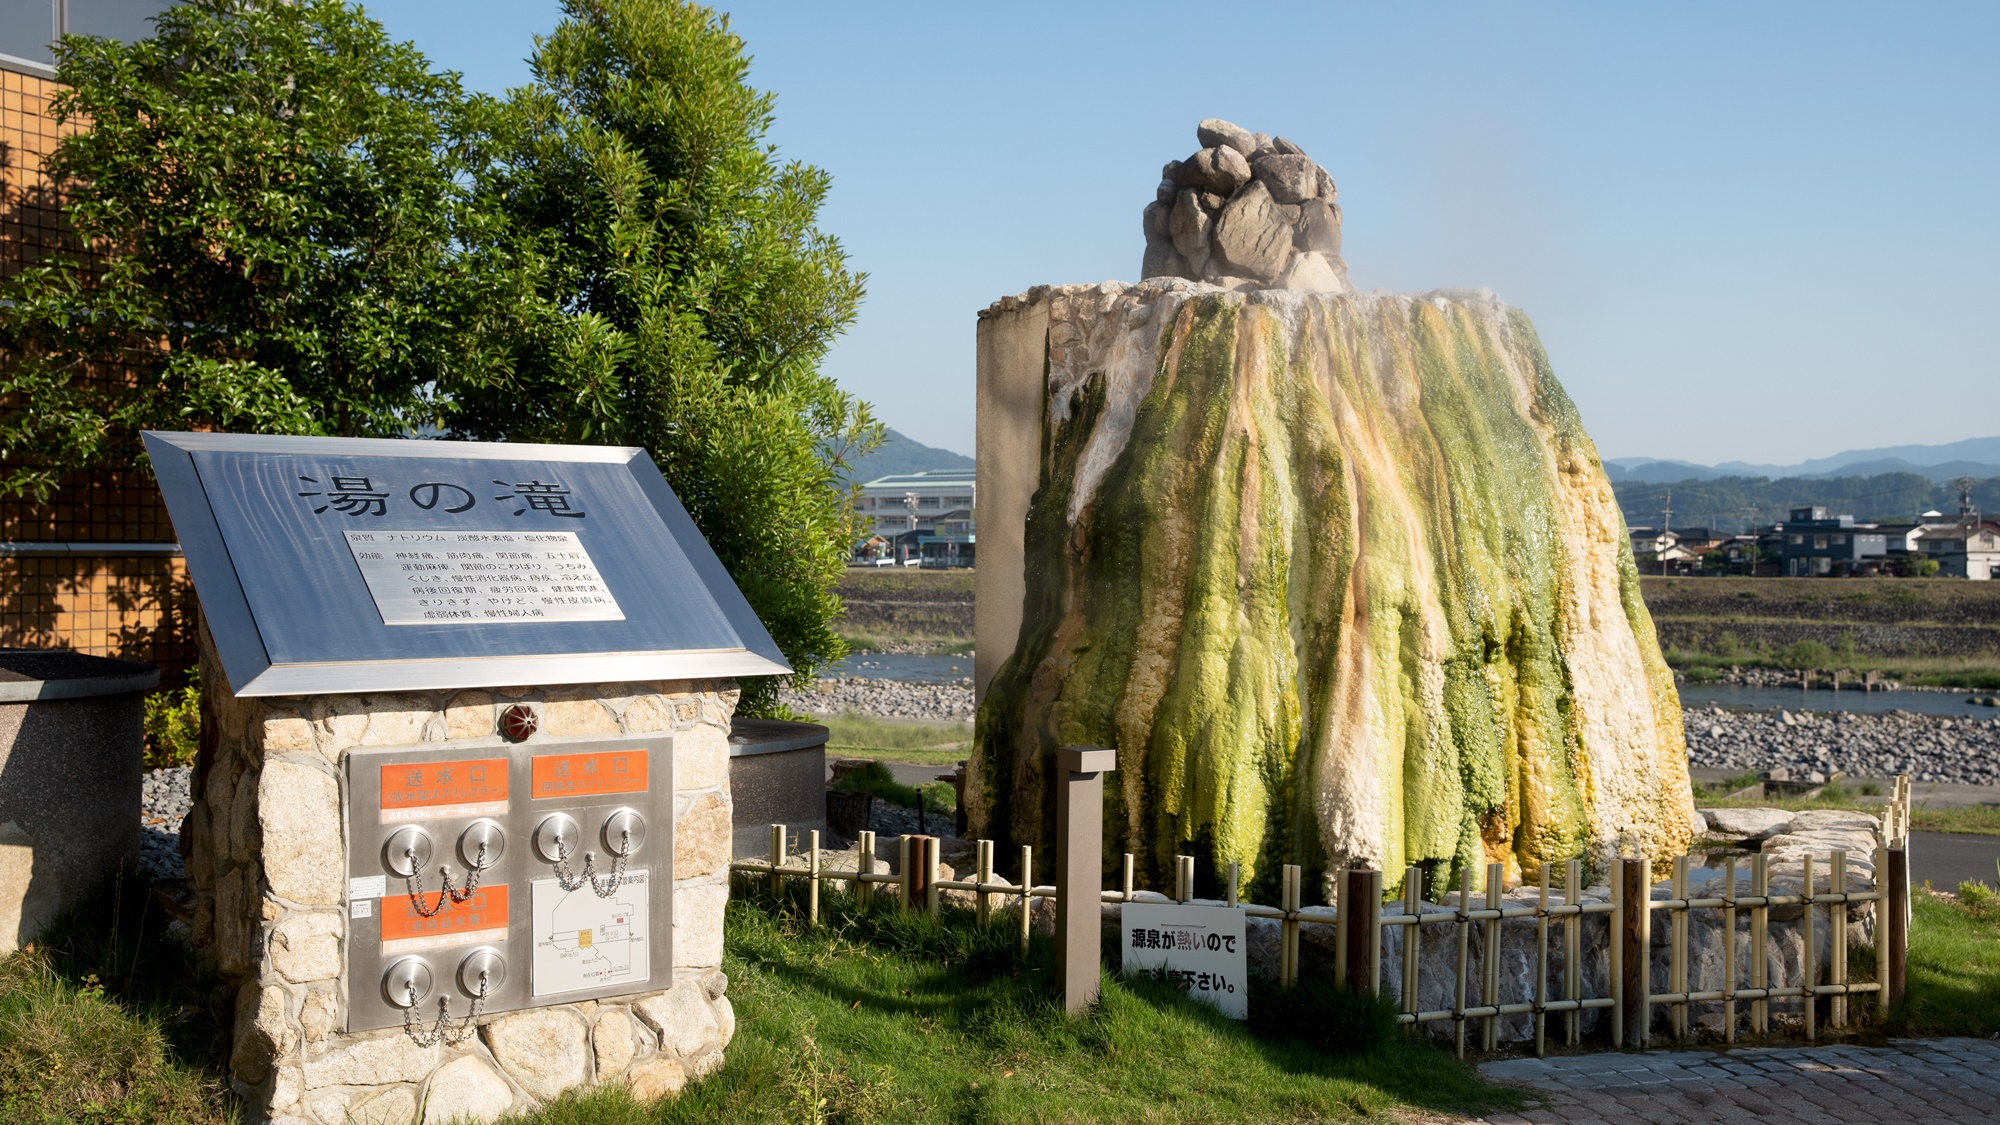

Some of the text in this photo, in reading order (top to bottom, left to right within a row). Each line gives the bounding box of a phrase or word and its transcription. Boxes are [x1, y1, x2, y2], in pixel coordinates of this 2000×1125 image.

[298, 475, 586, 519] 湯の滝
[350, 533, 375, 542] 泉質
[358, 552, 385, 560] 効能
[405, 766, 486, 787] 送水口
[553, 757, 628, 778] 送水口
[1131, 928, 1237, 954] 源泉が熱いので
[1138, 967, 1235, 994] 下さい。
